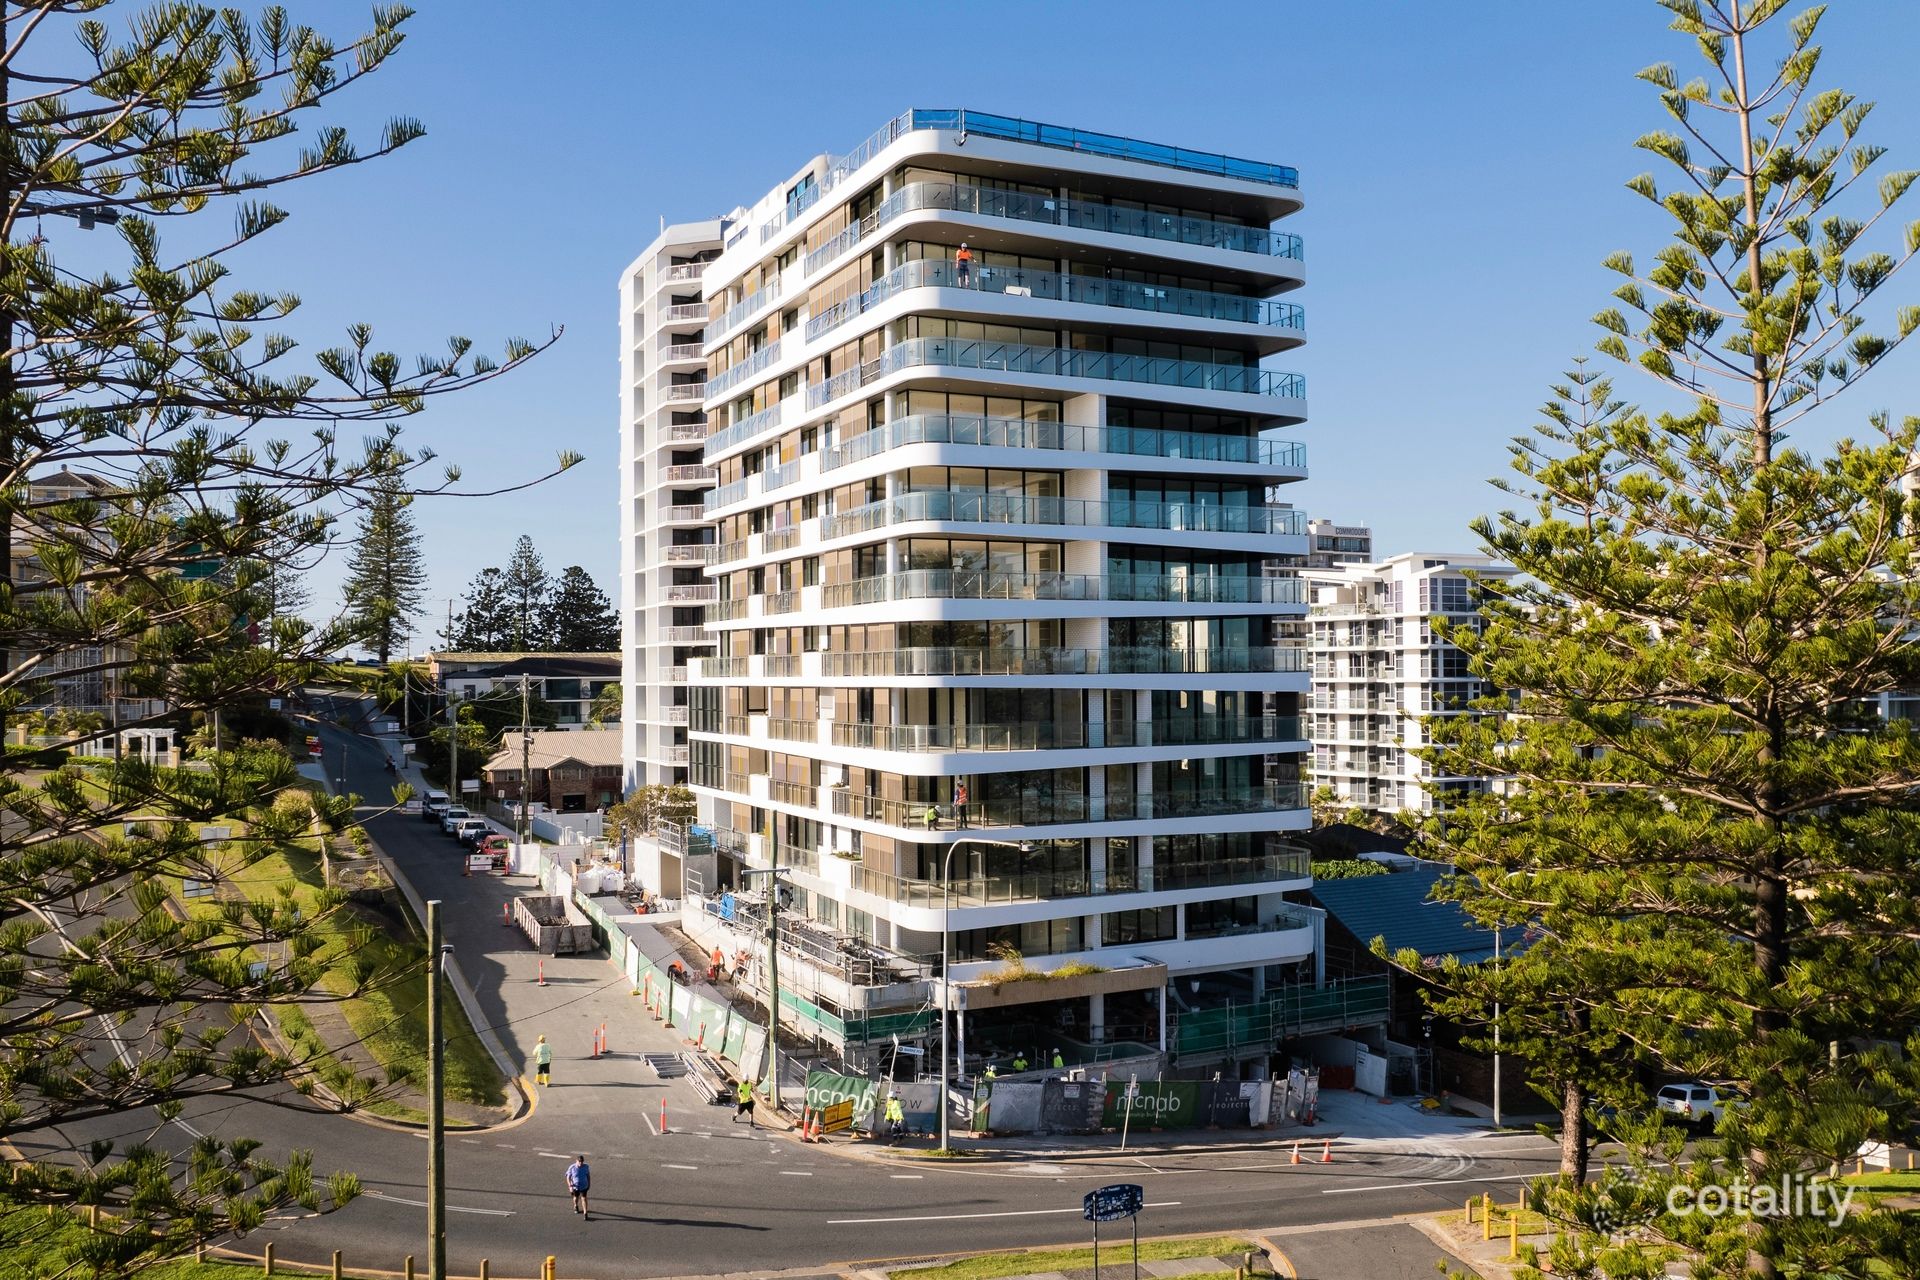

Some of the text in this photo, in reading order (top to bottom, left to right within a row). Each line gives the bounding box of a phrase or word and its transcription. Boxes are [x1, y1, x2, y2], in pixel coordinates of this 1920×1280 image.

[1335, 527, 1368, 536] COMMODORE
[880, 1098, 922, 1110] FOW
[1116, 1090, 1181, 1112] mcnab
